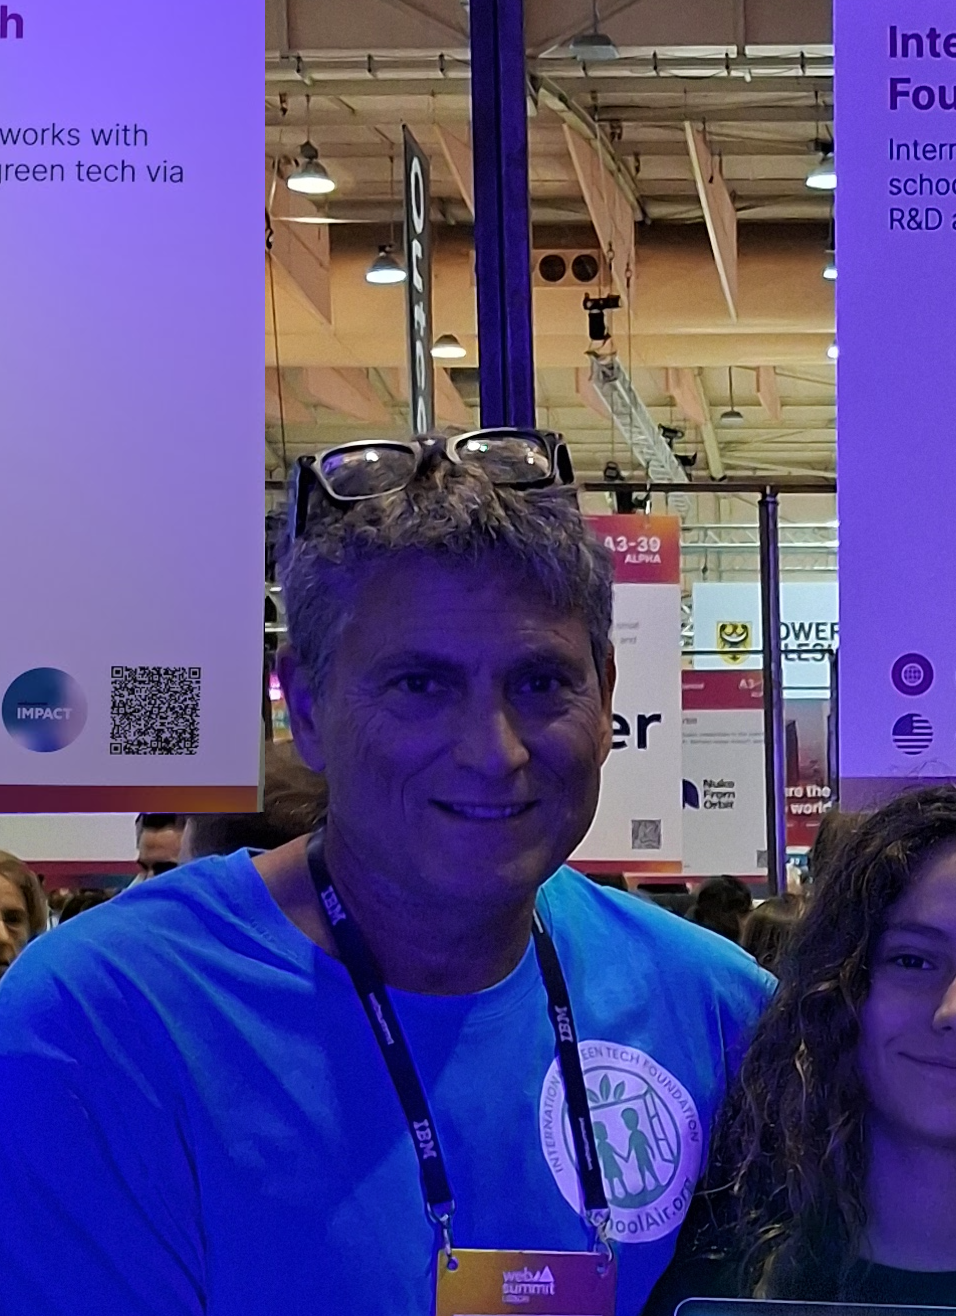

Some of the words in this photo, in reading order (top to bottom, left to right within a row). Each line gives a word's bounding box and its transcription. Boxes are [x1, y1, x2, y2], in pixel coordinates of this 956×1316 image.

[0, 123, 81, 147] works
[91, 123, 149, 147] with
[0, 162, 65, 185] reen
[75, 160, 136, 184] tech
[146, 160, 185, 184] via
[890, 208, 944, 232] R&D
[625, 554, 661, 564] ALPHA
[16, 707, 73, 721] IMPACT
[321, 885, 347, 926] IBM
[555, 1004, 574, 1044] IBM
[606, 1047, 641, 1065] TECH
[643, 1059, 700, 1144] FOUNDATION
[412, 1118, 438, 1161] IBM
[502, 1281, 556, 1296] summit
